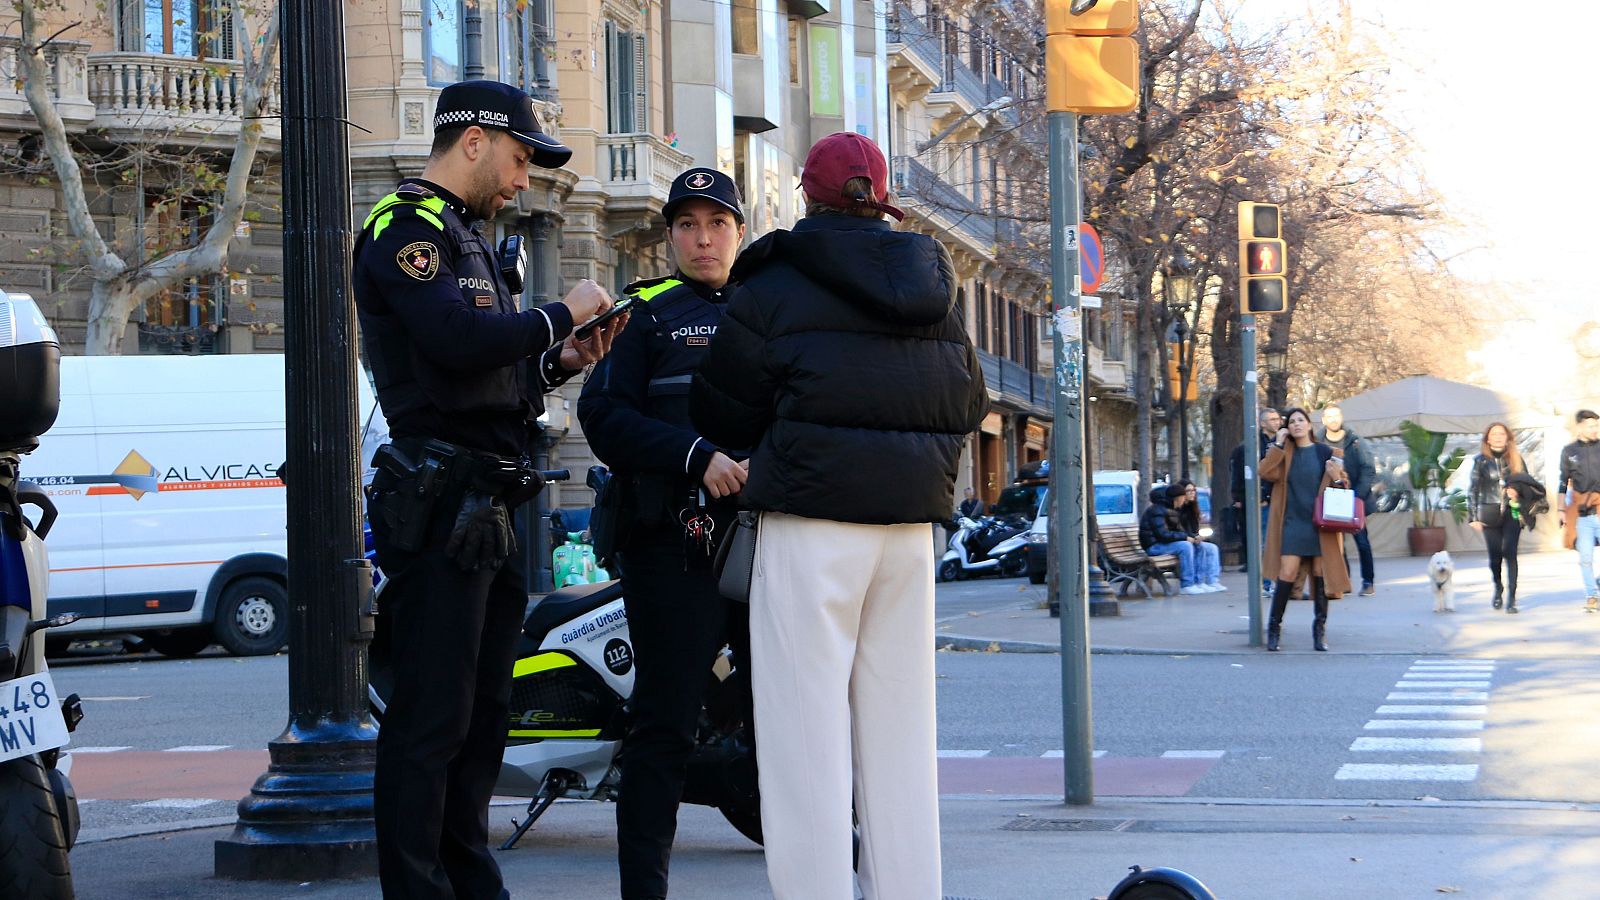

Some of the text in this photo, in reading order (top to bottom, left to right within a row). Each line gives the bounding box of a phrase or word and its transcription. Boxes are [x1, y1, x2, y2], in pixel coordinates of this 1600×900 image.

[816, 41, 832, 102] seguros
[479, 110, 509, 122] POLICIA
[562, 622, 596, 644] Guàrdia
[606, 646, 628, 664] 112
